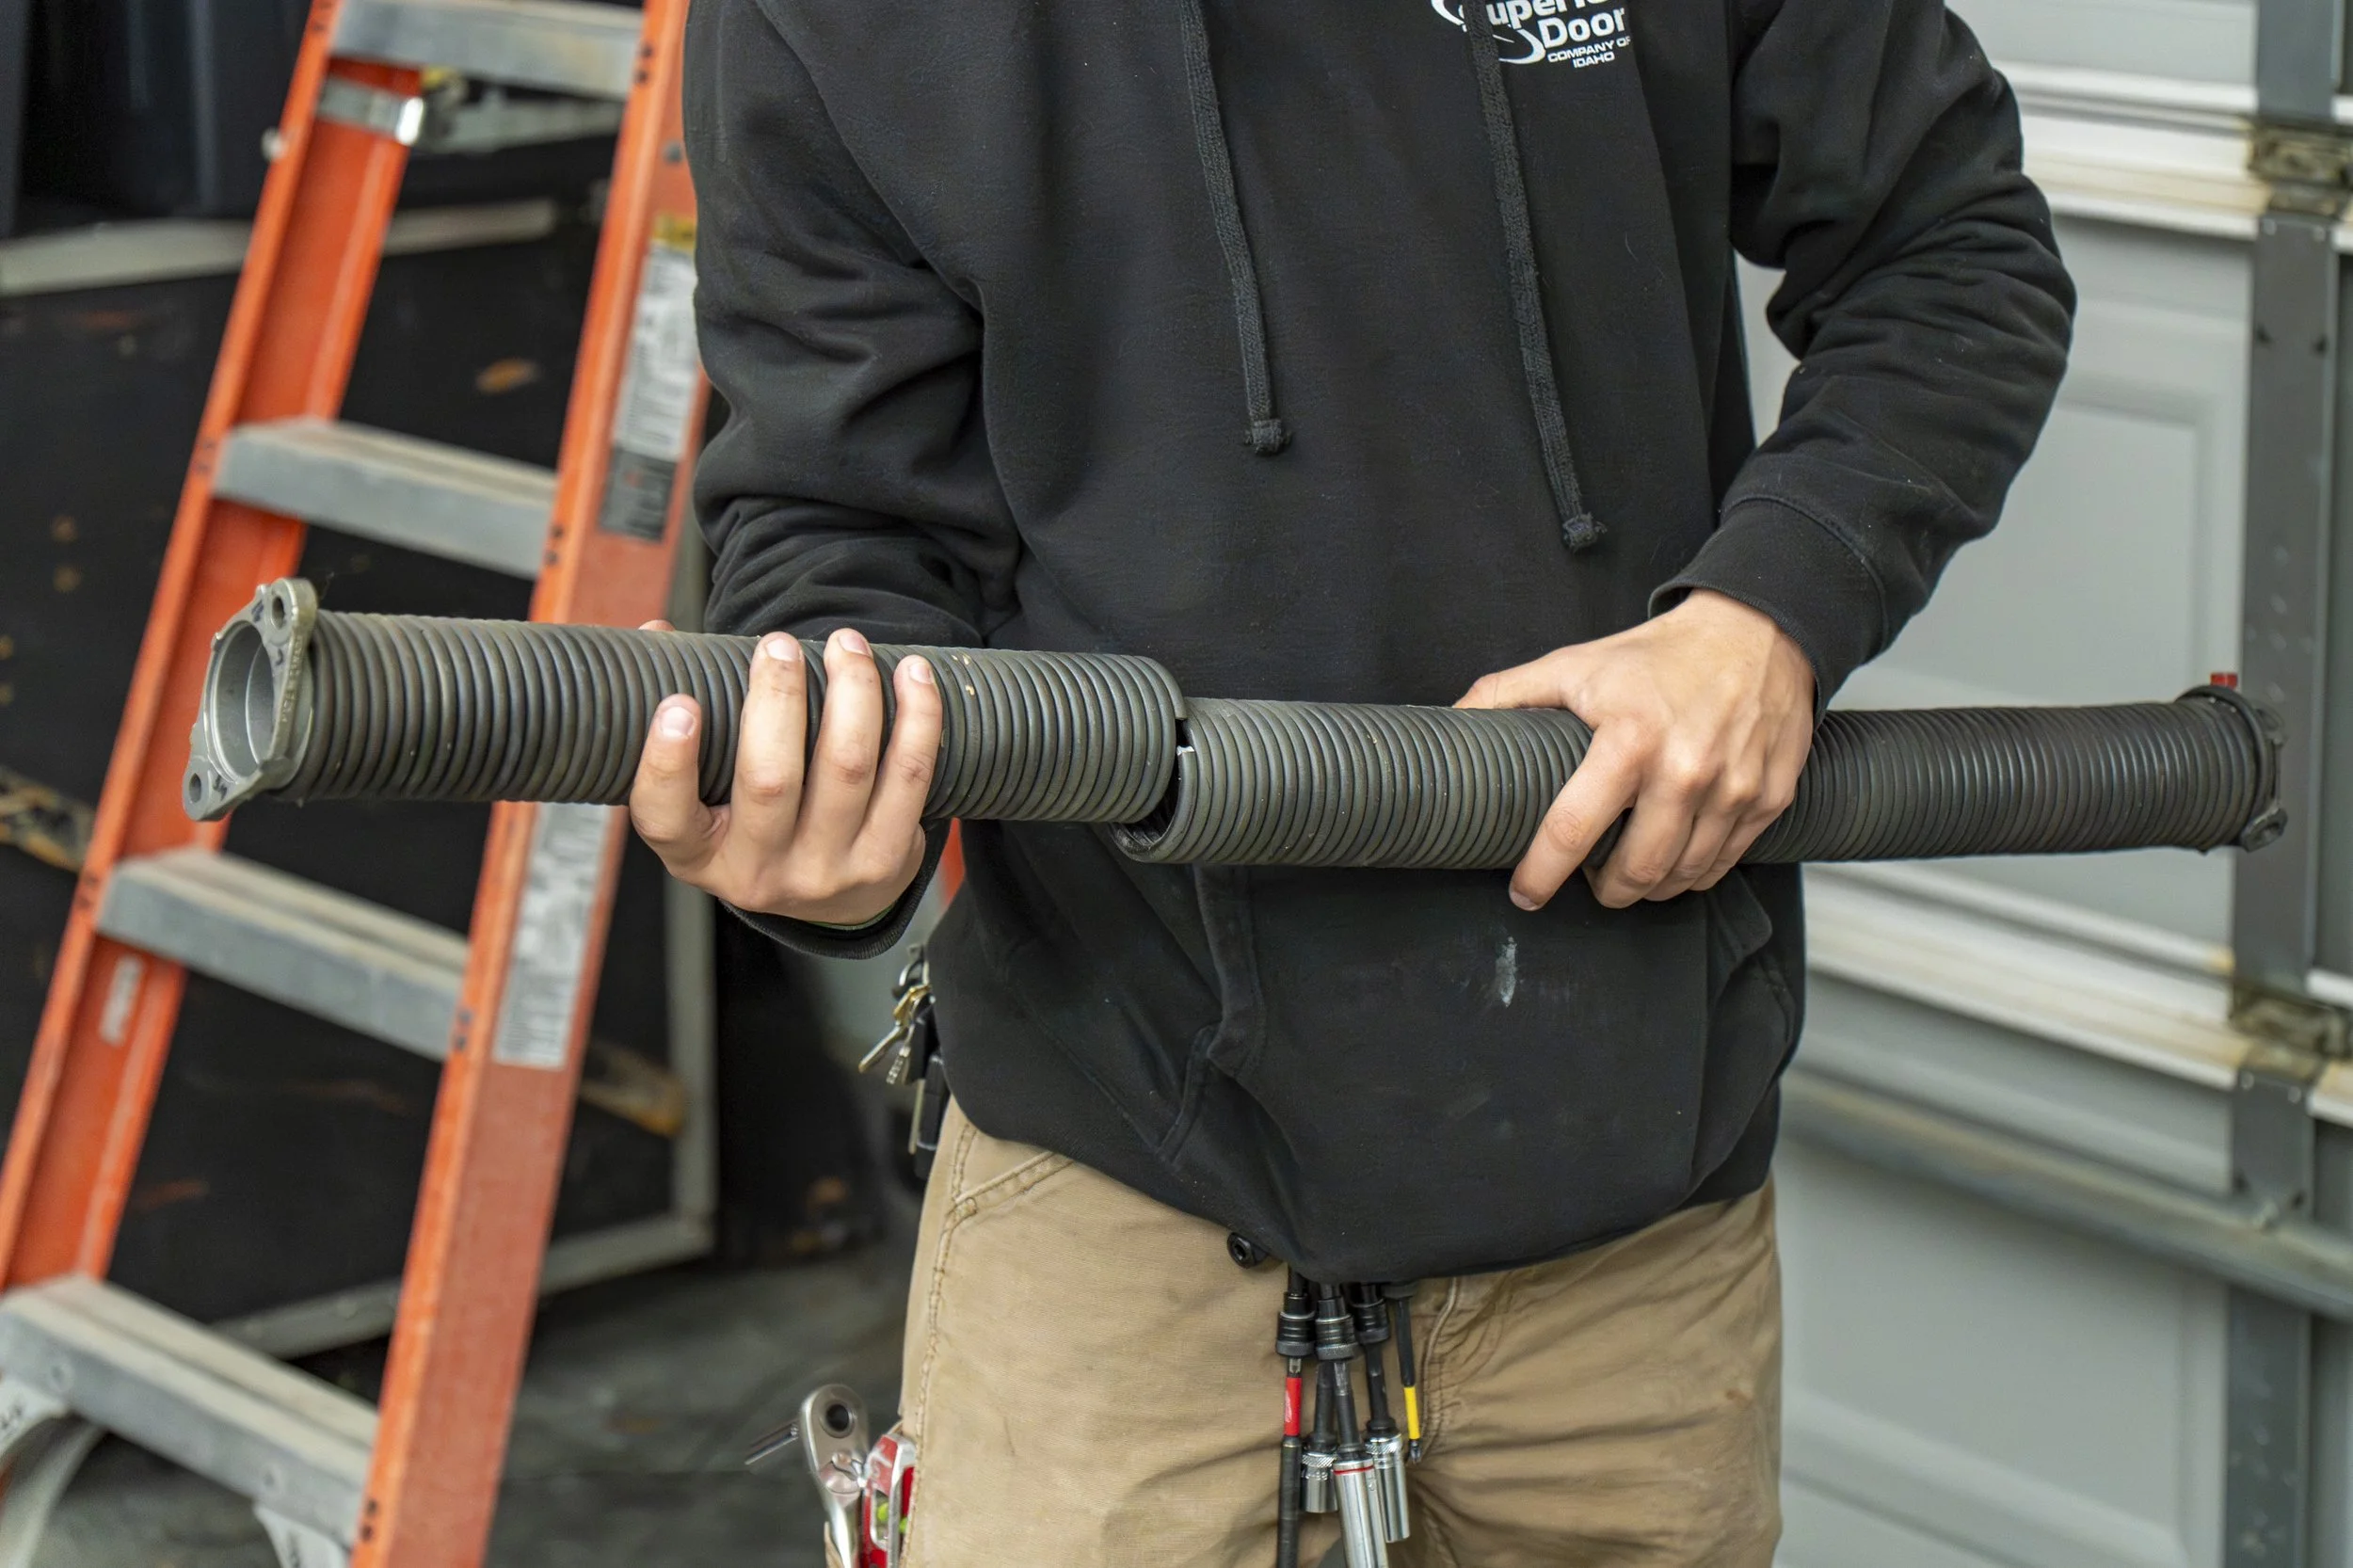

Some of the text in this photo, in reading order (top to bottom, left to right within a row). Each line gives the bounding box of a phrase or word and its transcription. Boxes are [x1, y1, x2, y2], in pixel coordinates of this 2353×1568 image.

[1538, 8, 1625, 48] Door
[1547, 40, 1615, 63] COMPANY
[1573, 51, 1615, 69] IDAHO
